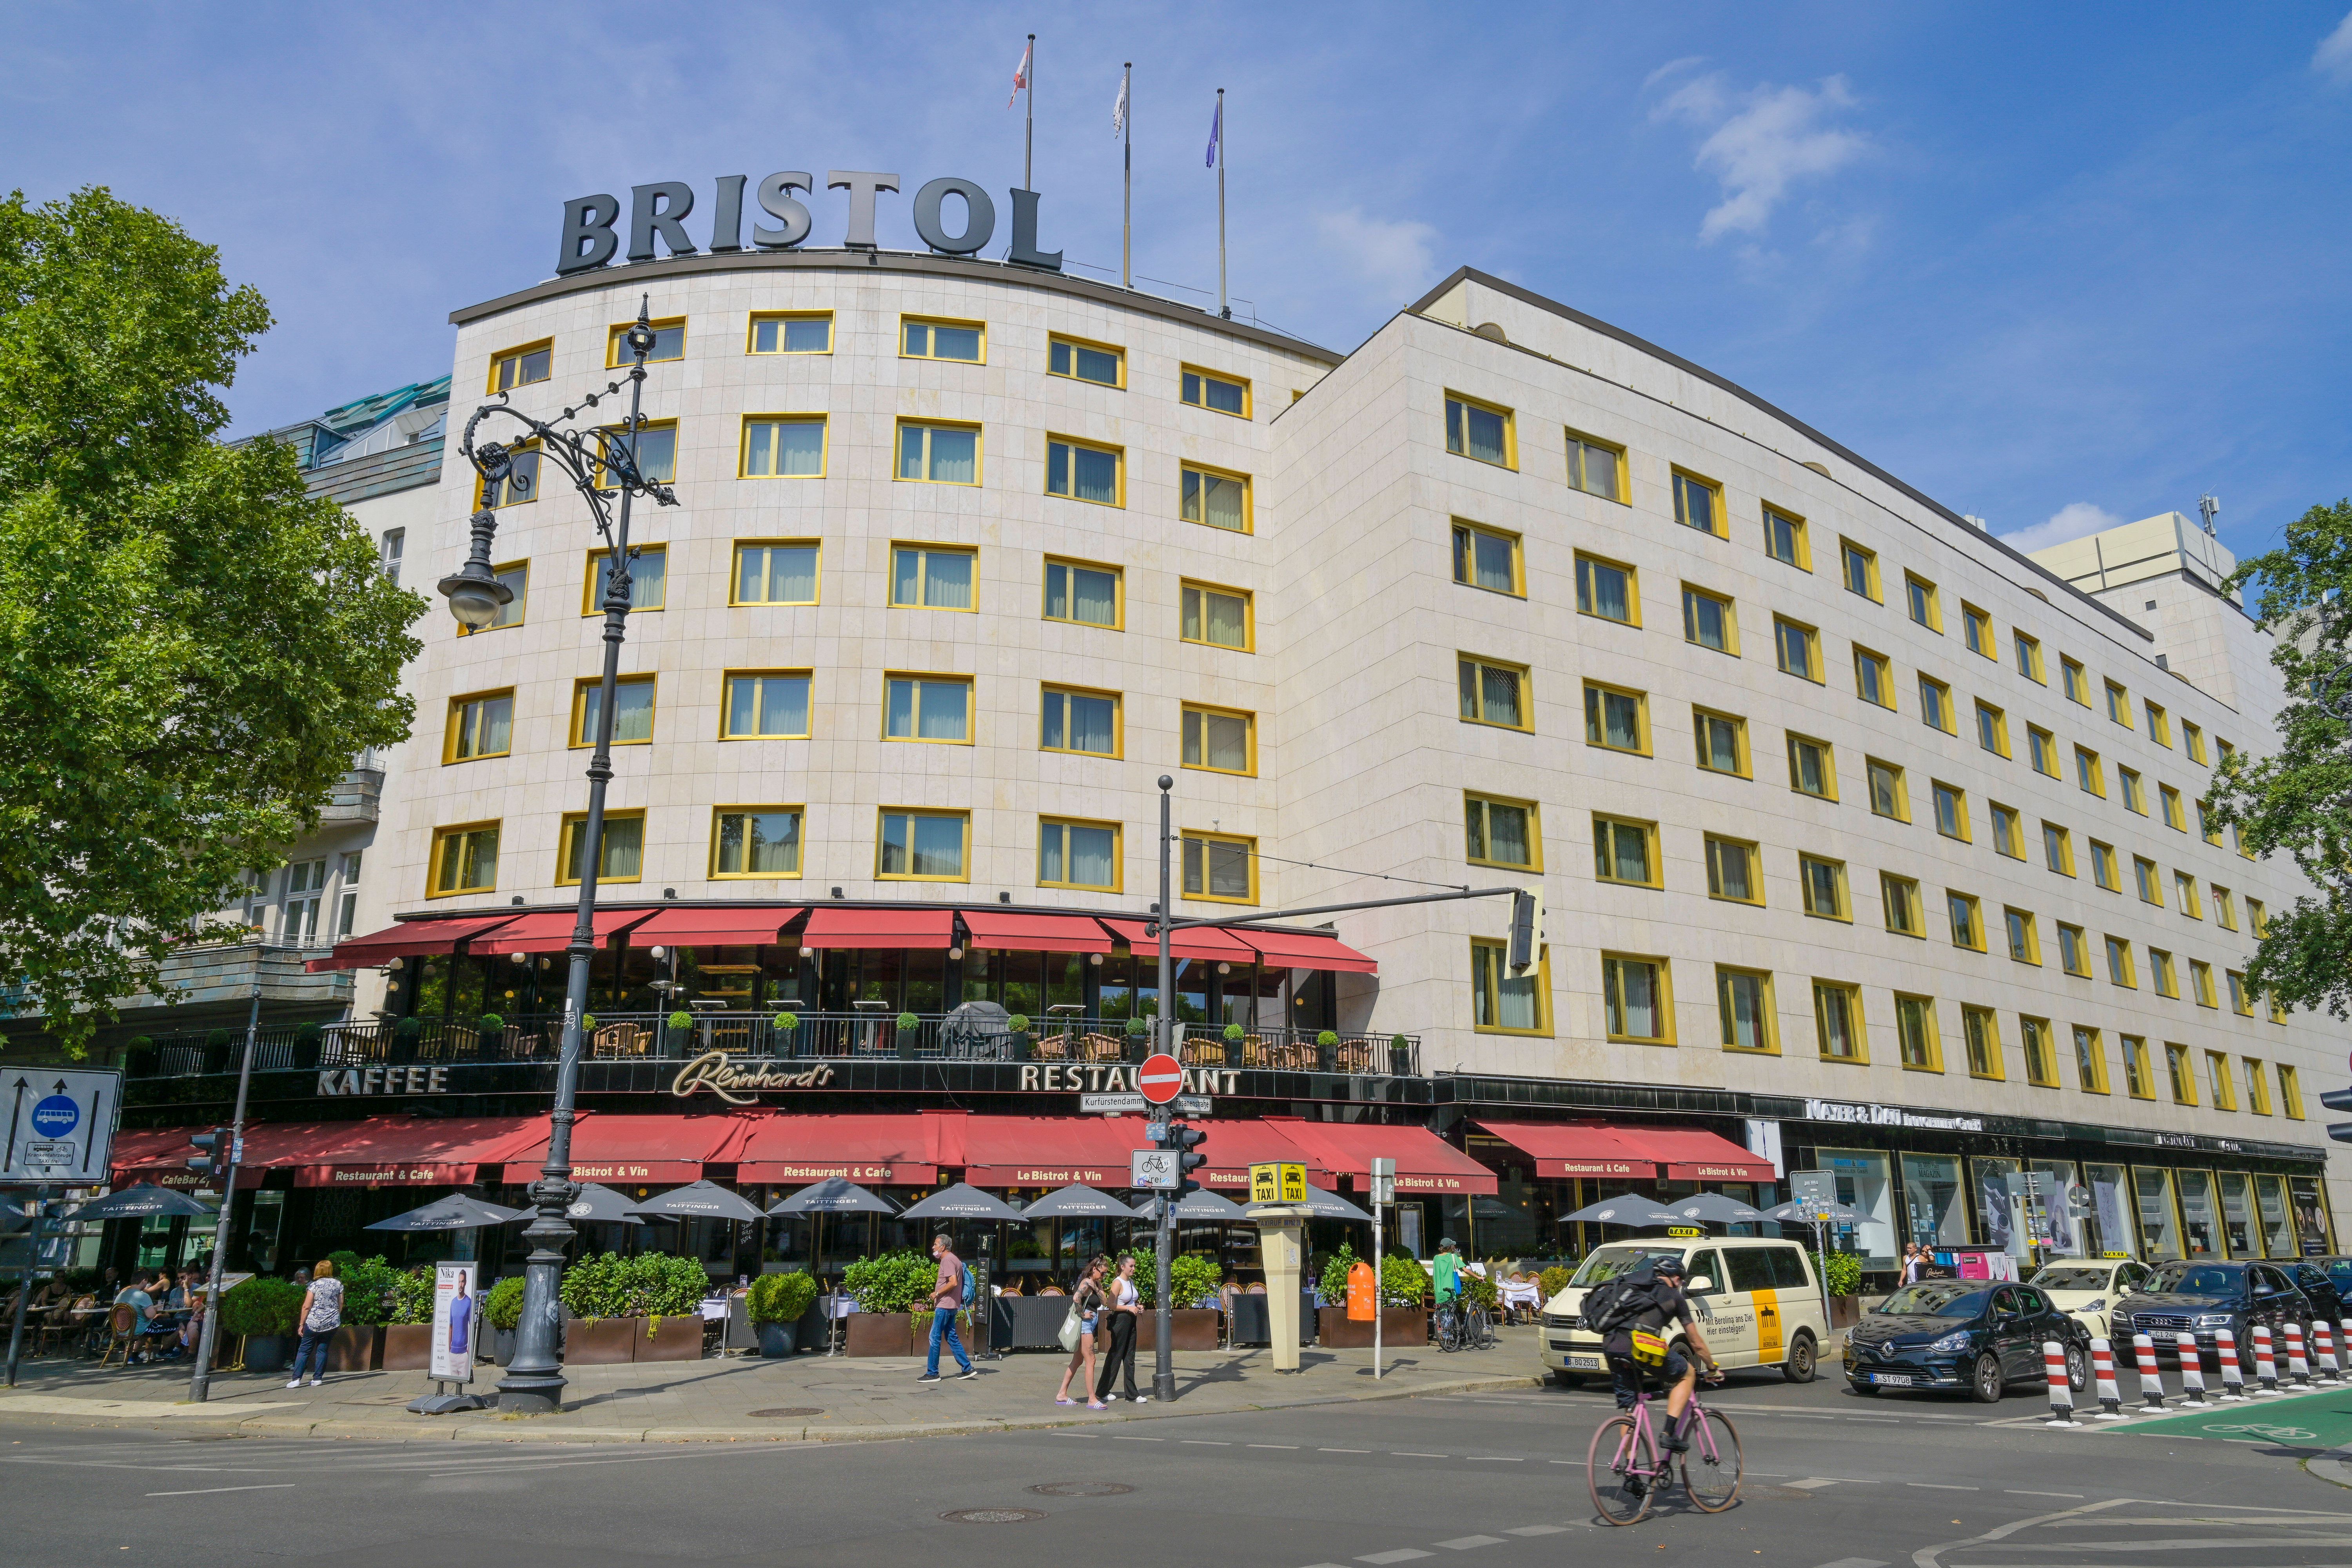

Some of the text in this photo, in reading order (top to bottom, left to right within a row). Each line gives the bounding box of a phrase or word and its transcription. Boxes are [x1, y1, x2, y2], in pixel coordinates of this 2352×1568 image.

[555, 170, 1063, 276] BRISTOL
[318, 1067, 448, 1095] KAFFEE
[673, 1051, 834, 1104] Reinhard's
[1085, 1096, 1142, 1106] Kurfürstendamm
[1176, 1097, 1209, 1109] Fasanenstraße
[1857, 1106, 1870, 1123] &
[573, 1166, 648, 1176] Bistrot & Vin
[784, 1167, 891, 1177] Restaurant & Cafe
[1565, 1163, 1604, 1172] Restaurant
[1614, 1164, 1630, 1173] Cafe
[1698, 1167, 1706, 1175] Le
[1706, 1167, 1728, 1176] Bistrot
[162, 1175, 198, 1185] CafeBar
[336, 1170, 434, 1180] Restaurant & Cafe
[1018, 1171, 1102, 1180] Le Bistrot & Vin
[1394, 1178, 1459, 1188] Le Bistrot & Vin
[1256, 1188, 1274, 1201] TAXI
[1285, 1188, 1302, 1200] TAXI
[982, 1235, 987, 1250] 27
[440, 1268, 454, 1278] Nika
[1715, 1316, 1734, 1325] Berolina
[1744, 1313, 1754, 1321] Ziel.
[1707, 1324, 1746, 1336] Hier einsteigen!
